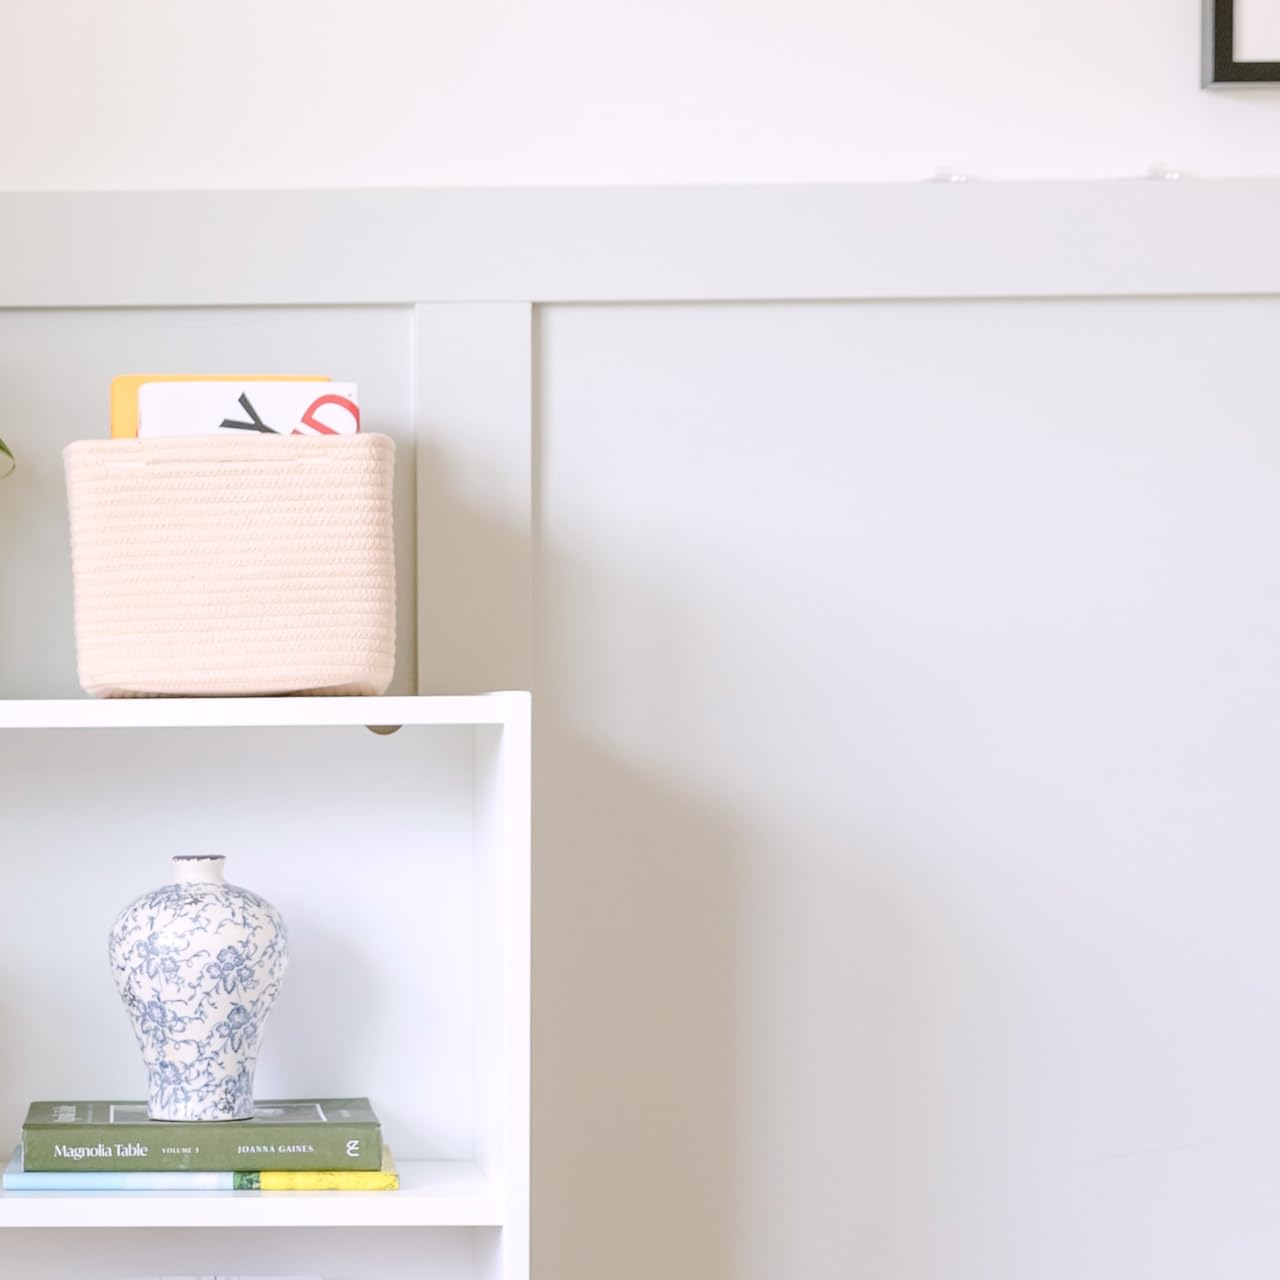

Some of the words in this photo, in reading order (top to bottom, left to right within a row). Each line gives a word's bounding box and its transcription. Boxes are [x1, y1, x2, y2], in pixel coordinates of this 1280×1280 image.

[54, 1143, 112, 1160] Magnolia
[114, 1142, 148, 1157] Table
[237, 1145, 275, 1154] JOANNA
[278, 1144, 314, 1153] GAINES
